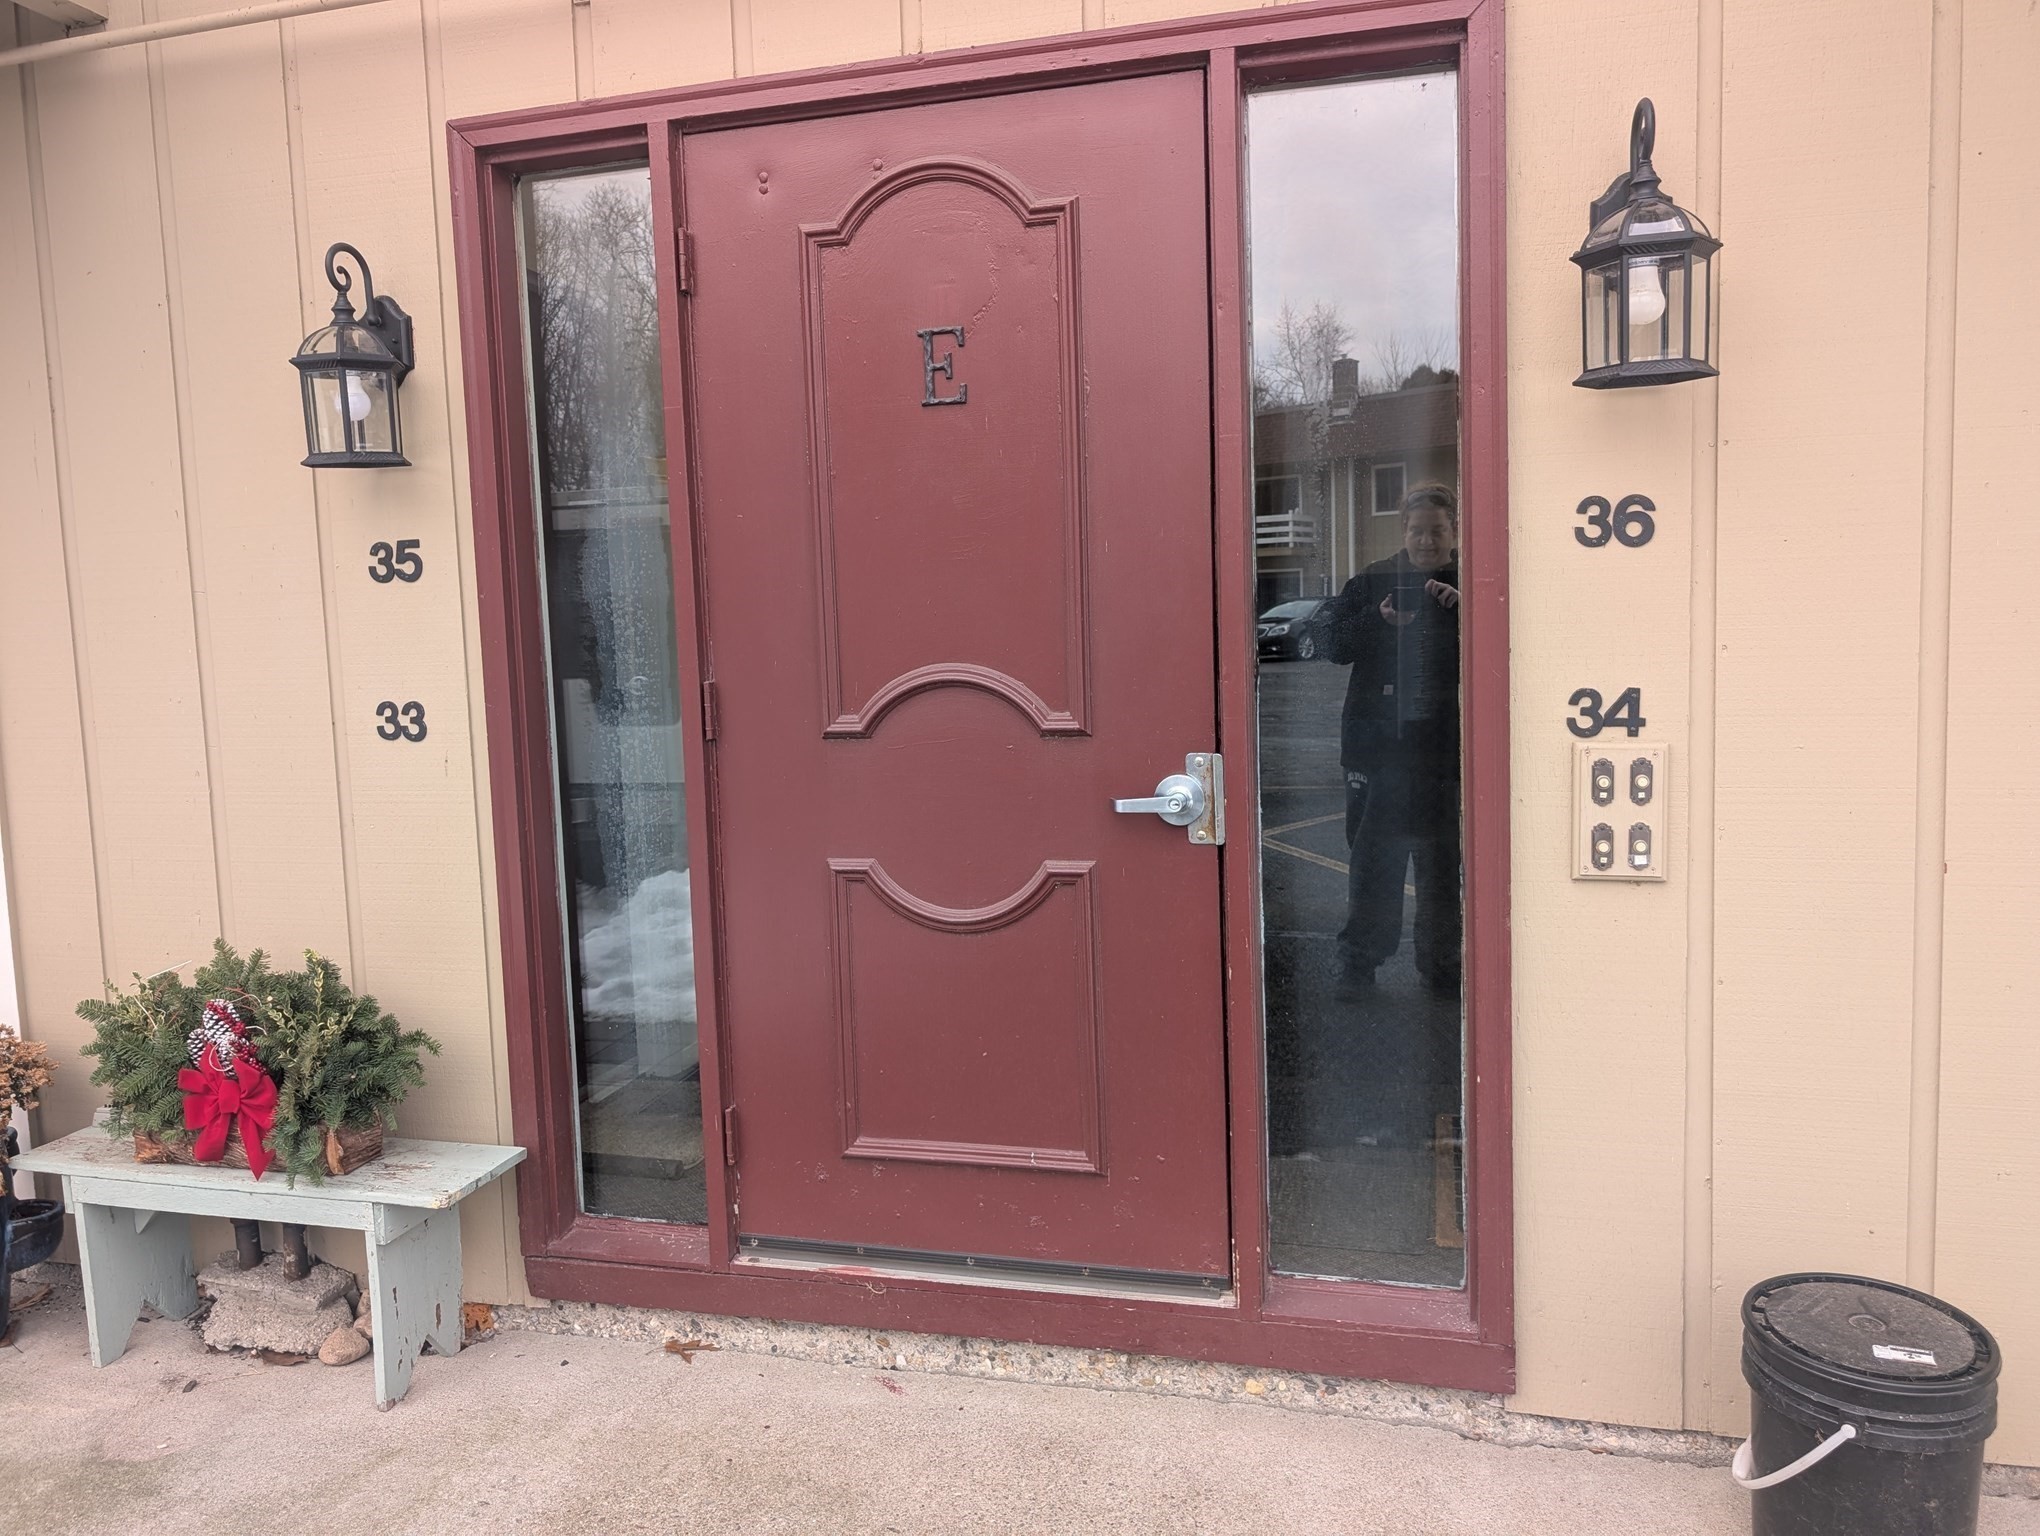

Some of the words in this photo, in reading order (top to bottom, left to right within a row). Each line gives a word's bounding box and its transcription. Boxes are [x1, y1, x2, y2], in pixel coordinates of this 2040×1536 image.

[917, 325, 967, 407] E
[1574, 494, 1656, 548] 36
[368, 538, 423, 584] 35
[376, 700, 428, 743] 33
[1566, 687, 1646, 738] 34
